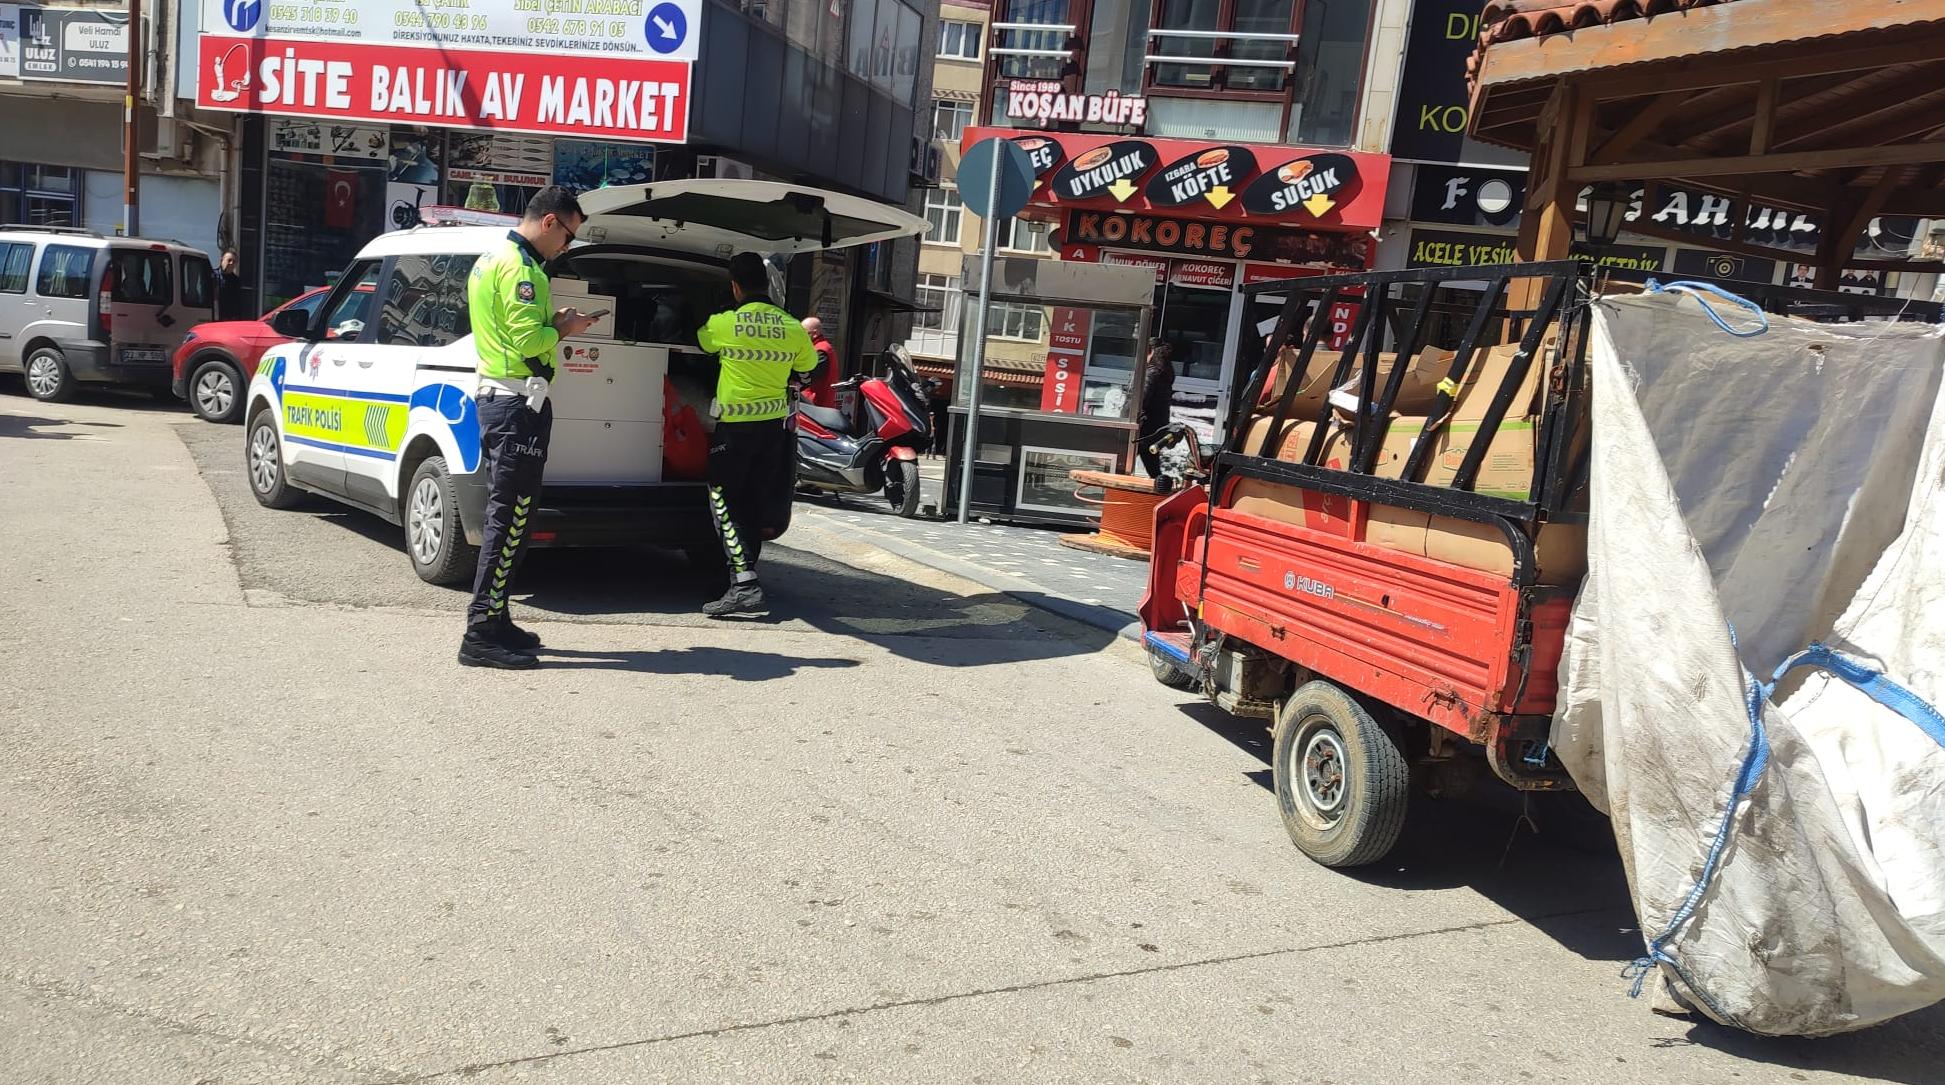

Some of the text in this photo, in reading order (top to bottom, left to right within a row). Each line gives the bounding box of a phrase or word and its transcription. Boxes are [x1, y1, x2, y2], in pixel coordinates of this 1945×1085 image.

[270, 5, 358, 24] 0545 318 39 40
[394, 11, 424, 27] 0544
[426, 13, 450, 28] 790
[471, 15, 487, 31] 96
[79, 26, 121, 36] Veli Hamdi
[527, 17, 626, 37] 0542 678 91 05
[25, 47, 56, 60] ULUZ
[90, 40, 109, 50] ULUZ
[259, 47, 680, 133] SİTE BALIK AV MARKET
[1010, 80, 1061, 93] Since 1989
[1007, 90, 1147, 127] KOŞAN BÜFE
[1069, 150, 1147, 197] UYKULUK
[1164, 162, 1198, 182] IZGARA
[1171, 162, 1233, 203] KÖFTE
[1271, 167, 1342, 212] SUCUK
[1077, 211, 1256, 258] KOKOREÇ
[1413, 241, 1466, 266] ACELE
[1181, 263, 1226, 277] KOKOREÇ
[736, 311, 785, 326] TRAFİK
[735, 324, 786, 340] POLİSİ
[1055, 335, 1081, 344] TOSTU
[287, 403, 342, 432] TRAFİK POLİSİ
[1297, 575, 1335, 600] KUBA
